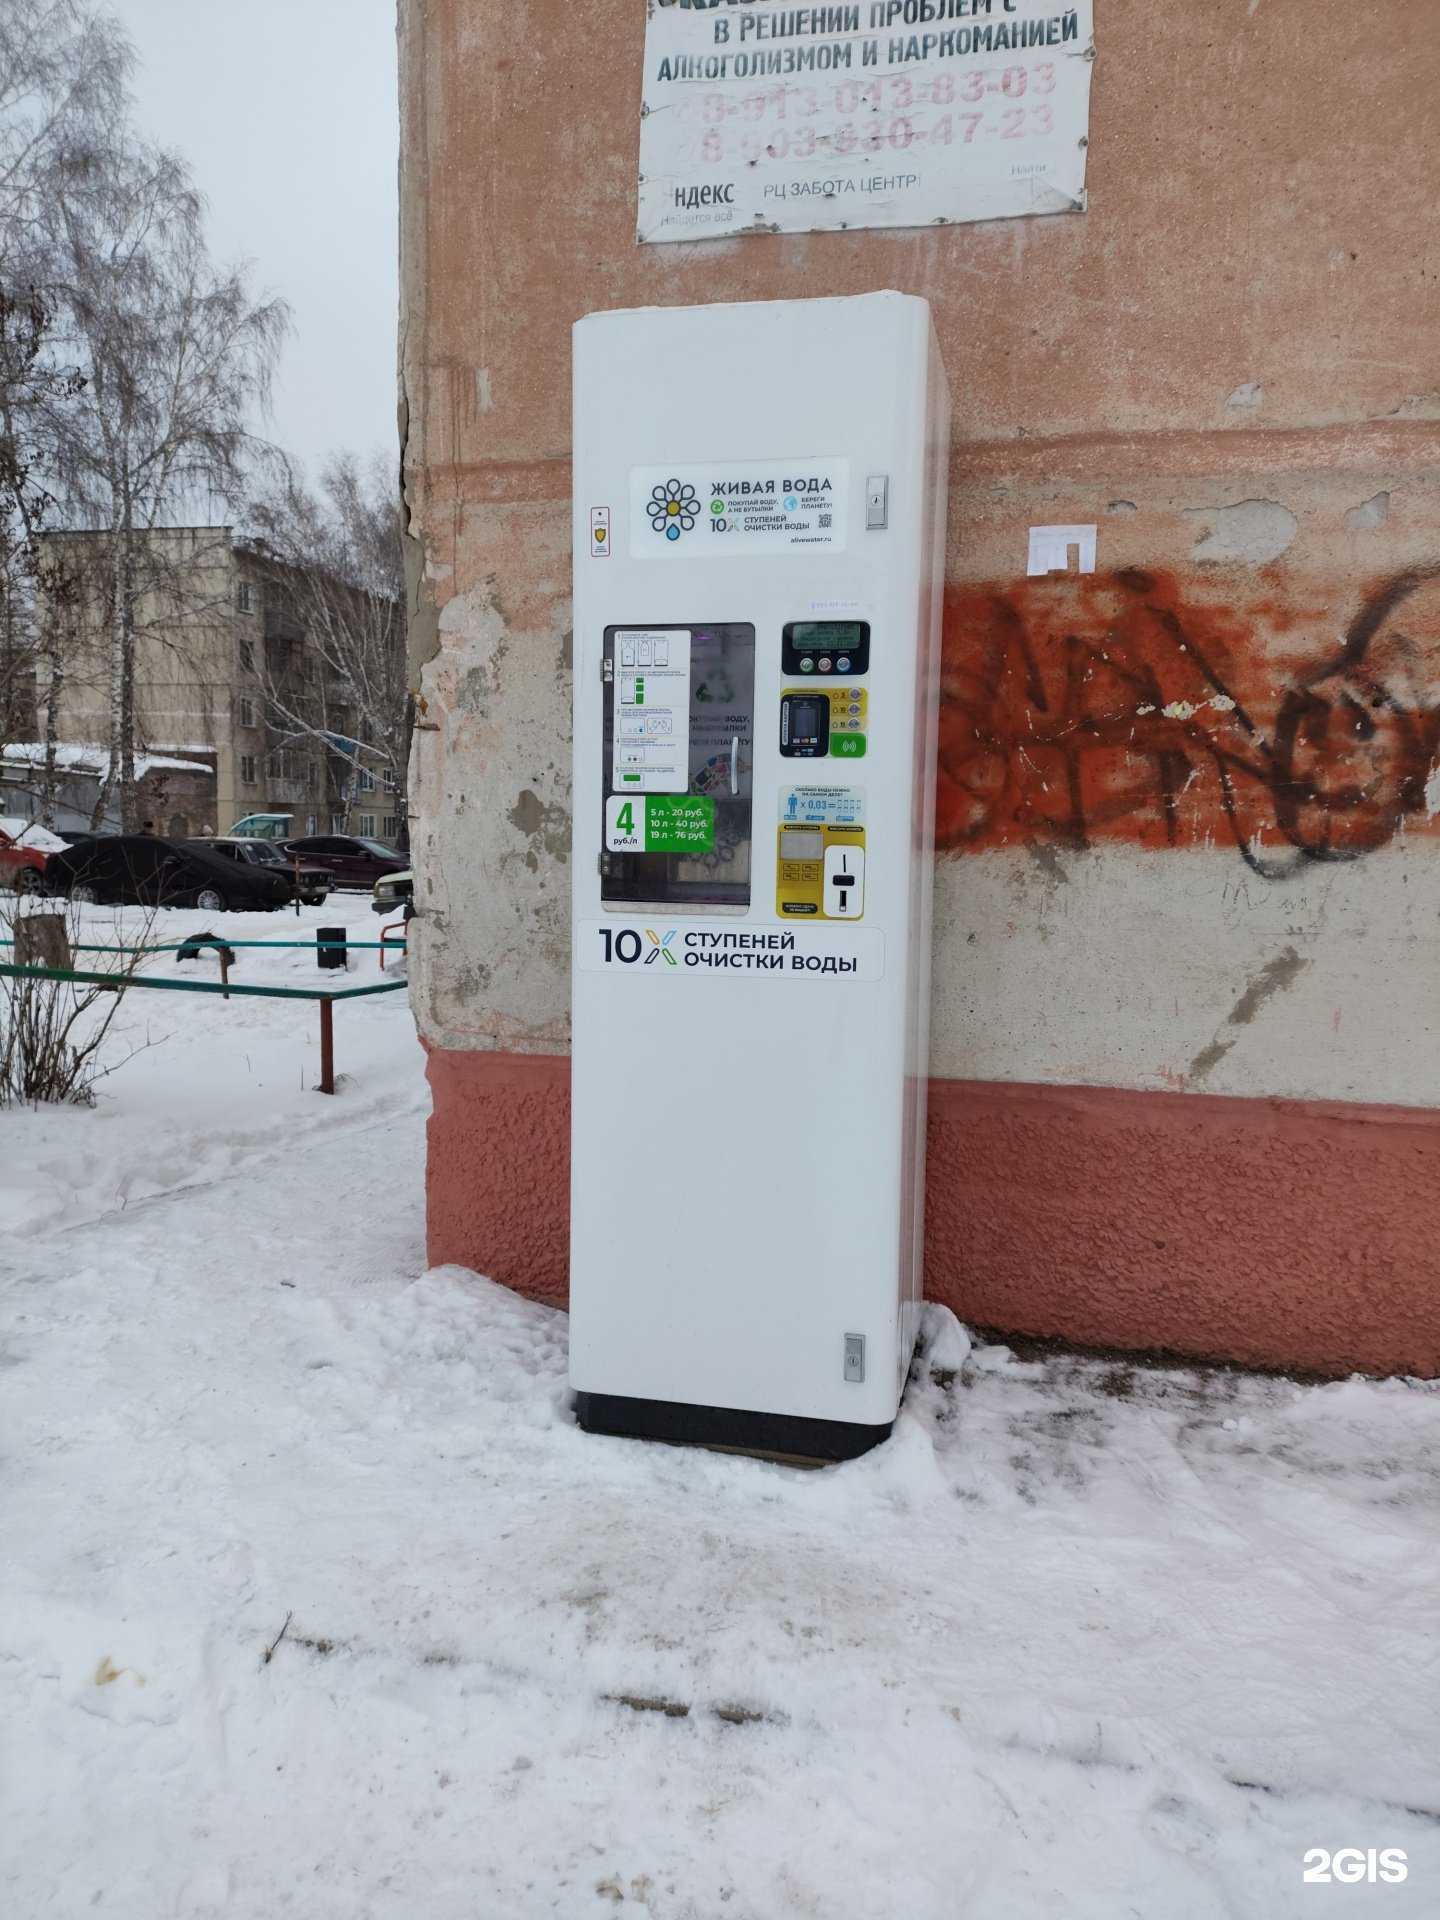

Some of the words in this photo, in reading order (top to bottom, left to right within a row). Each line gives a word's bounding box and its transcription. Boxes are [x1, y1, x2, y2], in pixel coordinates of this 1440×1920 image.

[714, 17, 730, 44] В
[740, 5, 860, 41] РЕШЕНИИ
[869, 0, 991, 28] ПРОБЛЕМ
[657, 43, 851, 81] АЛКОГОЛИЗМОМ
[862, 40, 878, 66] И
[888, 8, 1078, 64] НАРКОМАНИЕЙ
[664, 180, 735, 209] ндекс
[790, 177, 855, 197] ЗАБОТА
[860, 173, 917, 194] ЦЕНТР
[710, 480, 775, 496] ЖИВАЯ
[782, 478, 832, 494] ВОДА
[744, 515, 787, 524] СТУПЕНЕЙ
[744, 524, 782, 532] ОЧИСТКИ
[616, 802, 635, 835] 4
[684, 931, 795, 951] СТУПЕНЕЙ
[684, 952, 784, 970] ОЧИСТКИ
[791, 955, 858, 974] ВОДЫ
